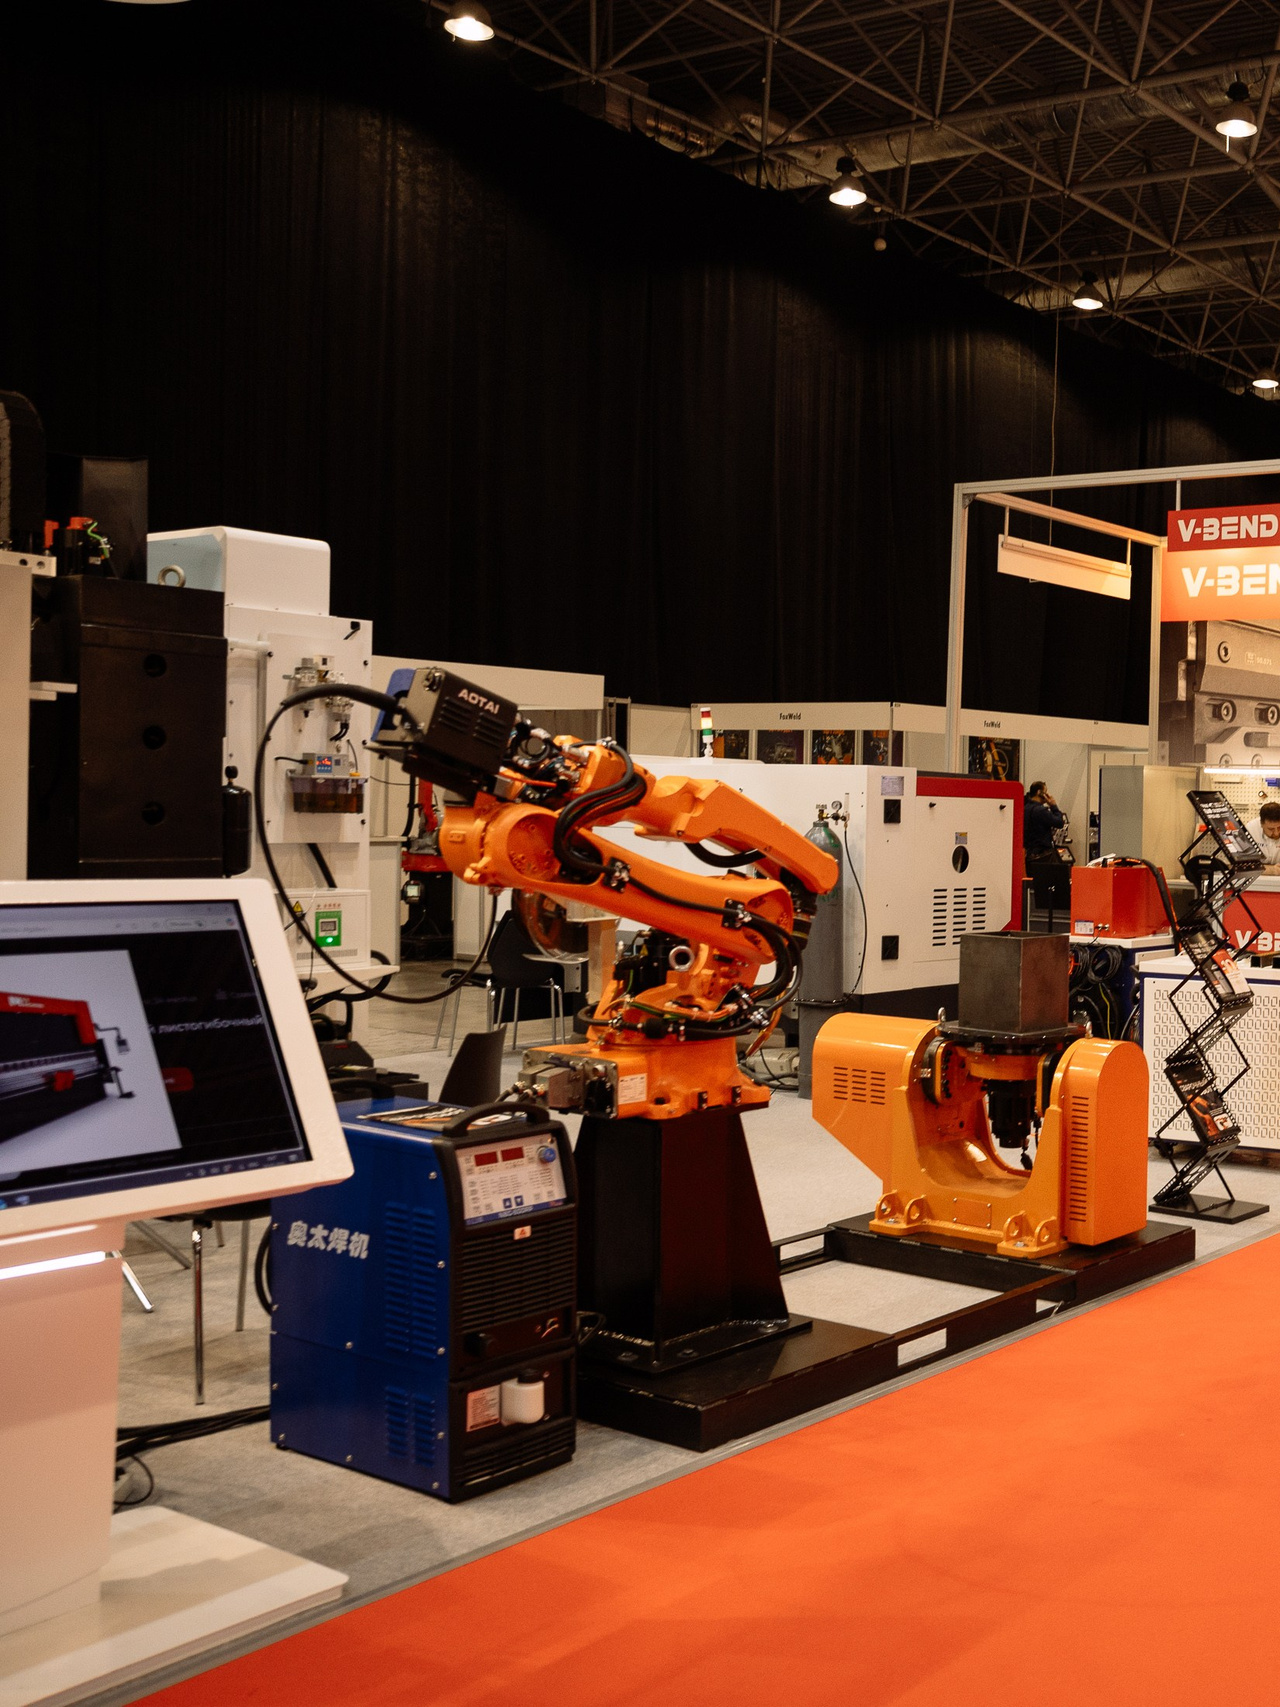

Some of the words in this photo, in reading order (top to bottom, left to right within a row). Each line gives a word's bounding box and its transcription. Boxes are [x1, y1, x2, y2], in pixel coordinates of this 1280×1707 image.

[1178, 513, 1279, 543] V-BEND
[458, 688, 500, 714] AOTAI
[779, 711, 802, 720] FoxWeld
[287, 1220, 370, 1260] 奥太焊机
